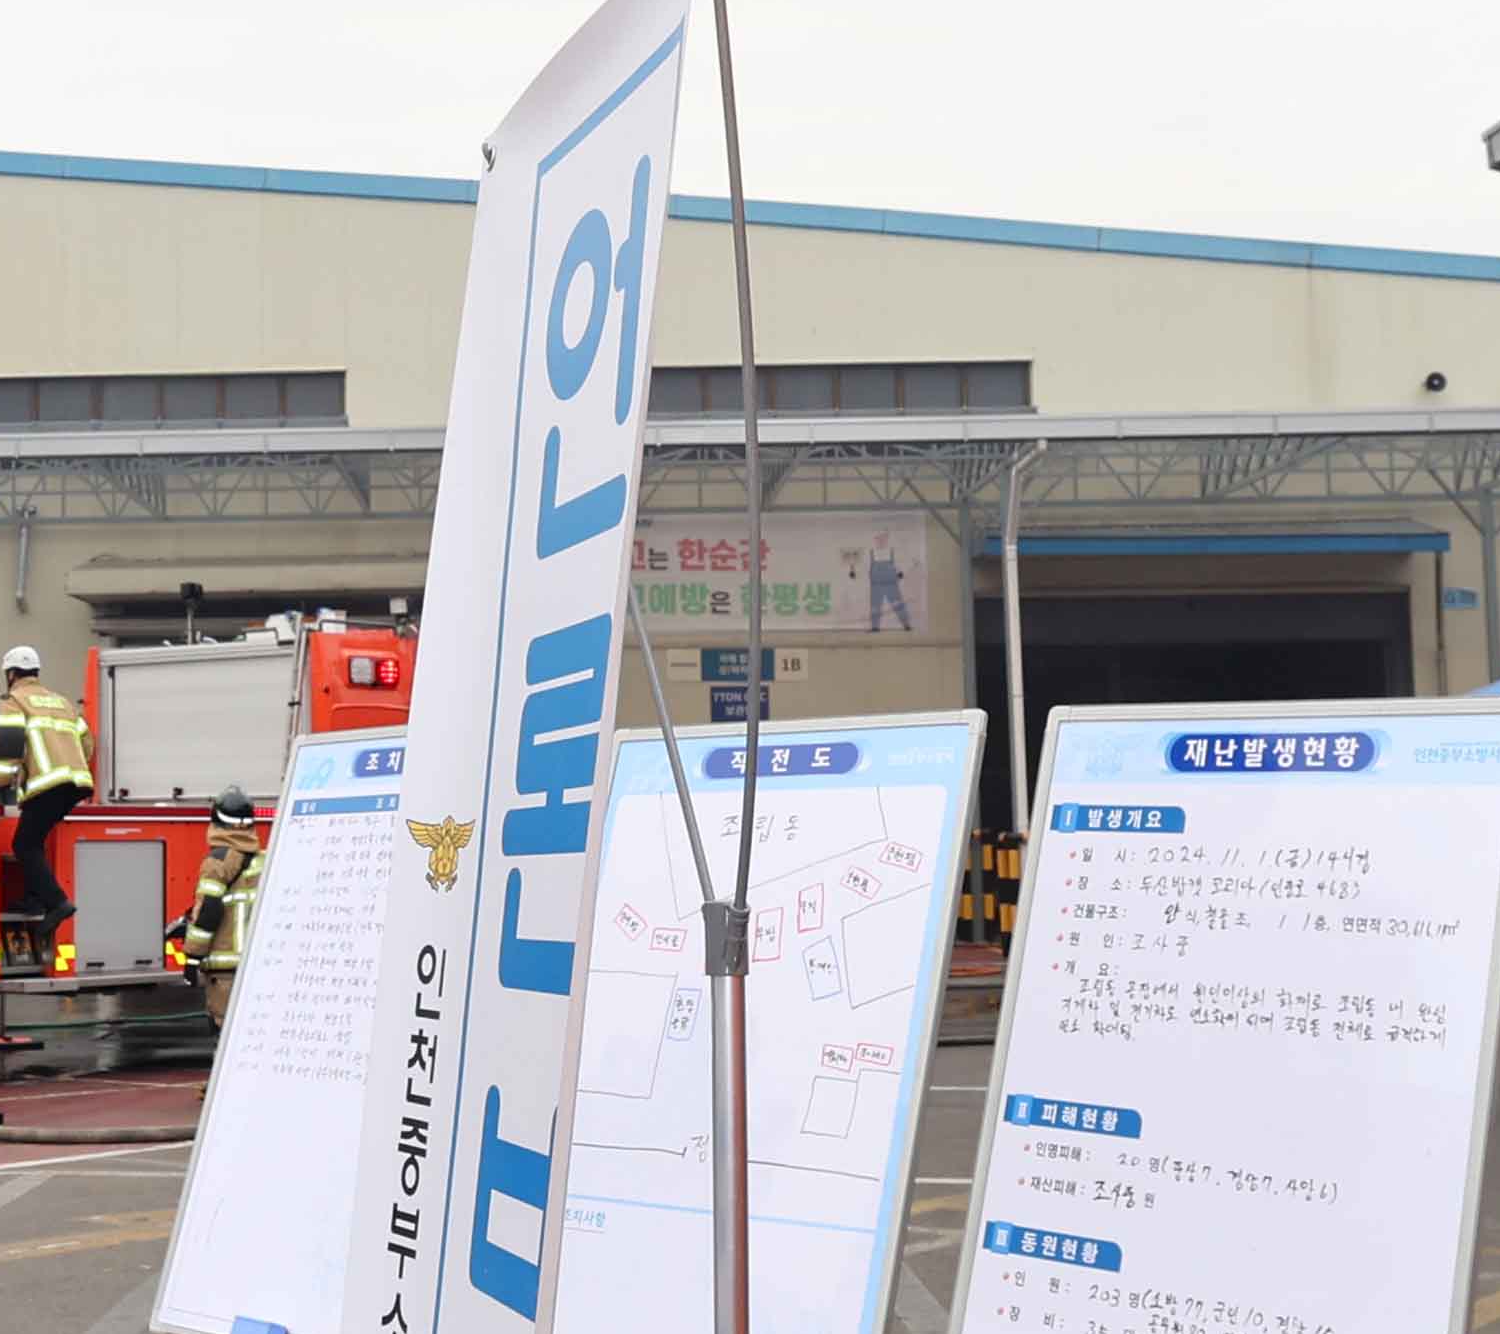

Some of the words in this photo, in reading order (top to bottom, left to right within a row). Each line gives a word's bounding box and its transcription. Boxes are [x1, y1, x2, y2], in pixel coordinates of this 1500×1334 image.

[677, 538, 770, 571] 한순간
[1183, 734, 1361, 769] 재난발생현황
[1087, 808, 1163, 829] 발생개요
[1040, 1102, 1120, 1132] 피해현황
[1020, 1231, 1101, 1265] 동원현황
